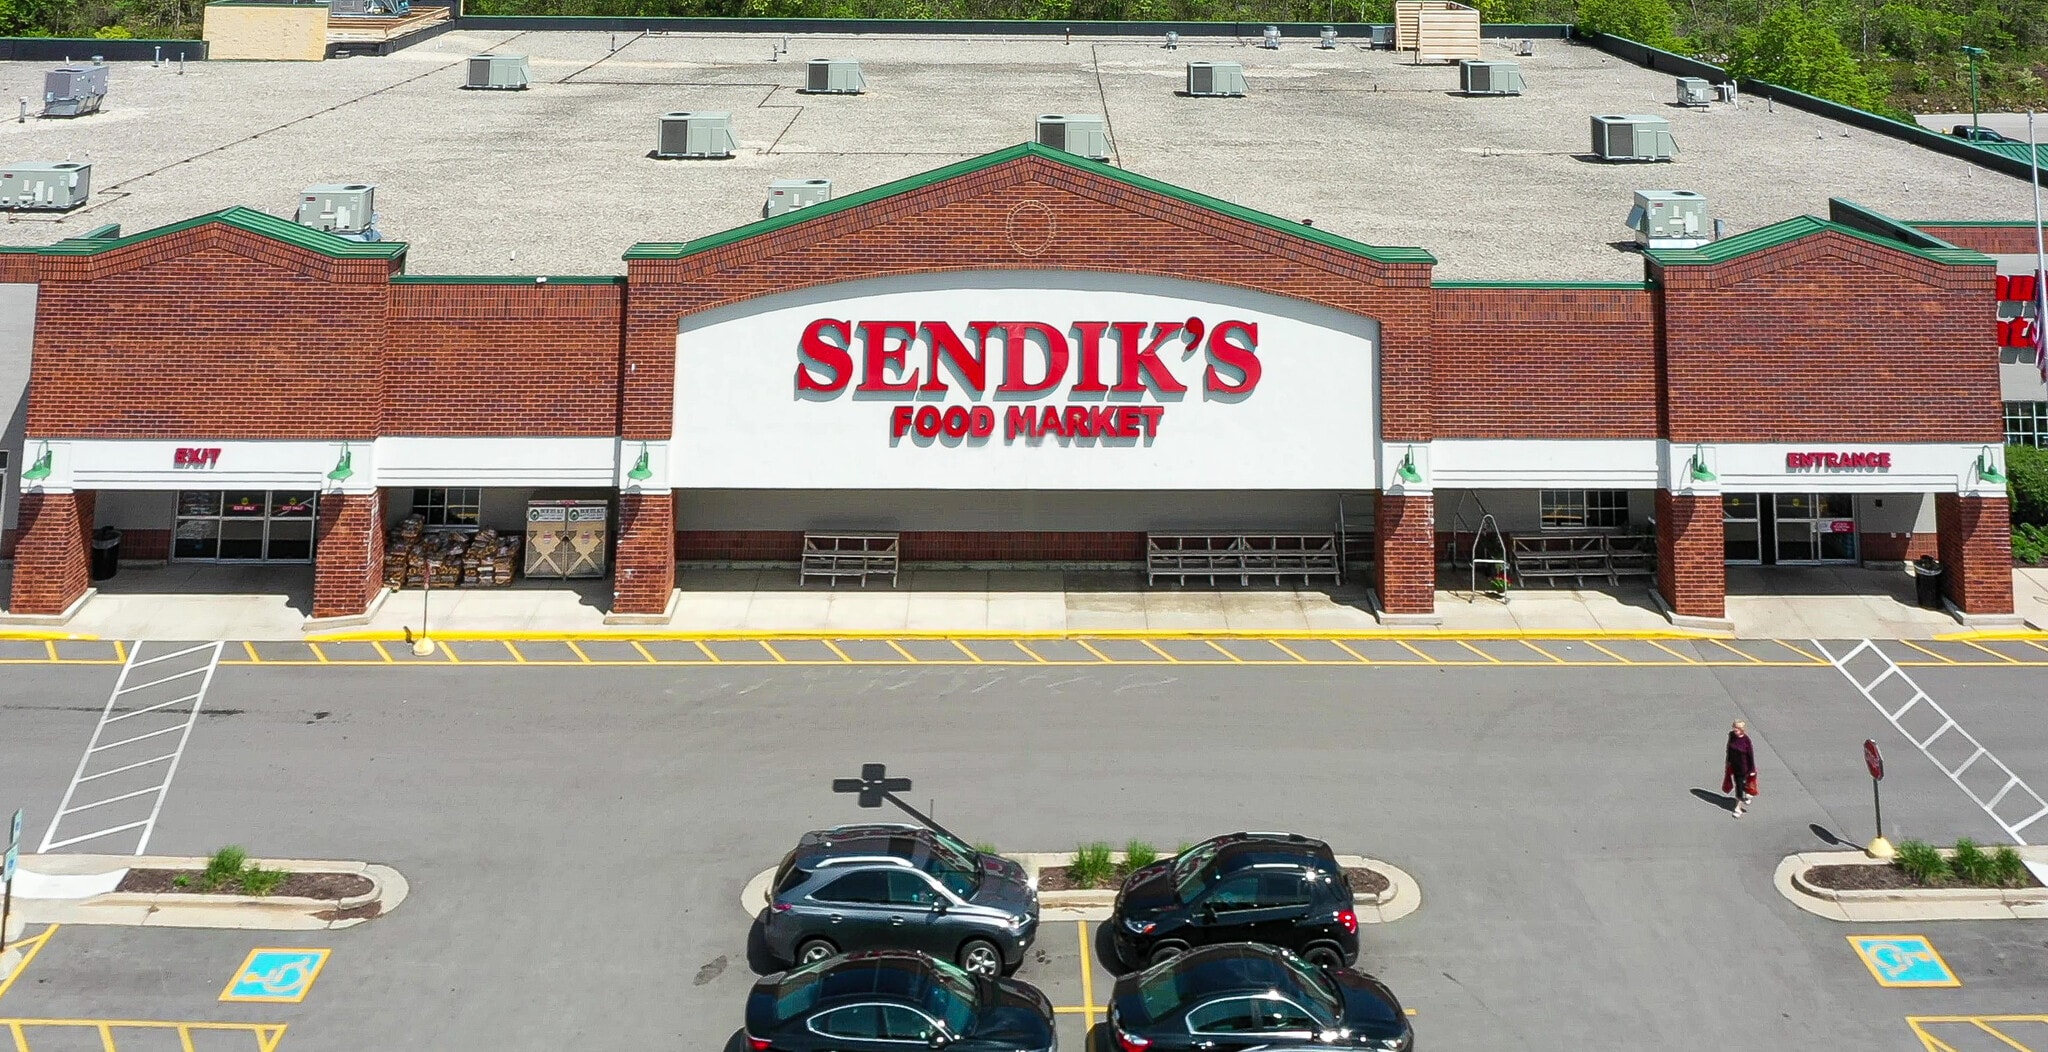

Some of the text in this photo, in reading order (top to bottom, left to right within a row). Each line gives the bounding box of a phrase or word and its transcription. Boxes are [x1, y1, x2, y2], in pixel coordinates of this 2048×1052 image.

[797, 317, 1262, 393] SENDIK'S
[893, 405, 1165, 439] FOOD MARKET
[175, 448, 221, 464] EXIT
[1787, 452, 1891, 468] ENTRANCE
